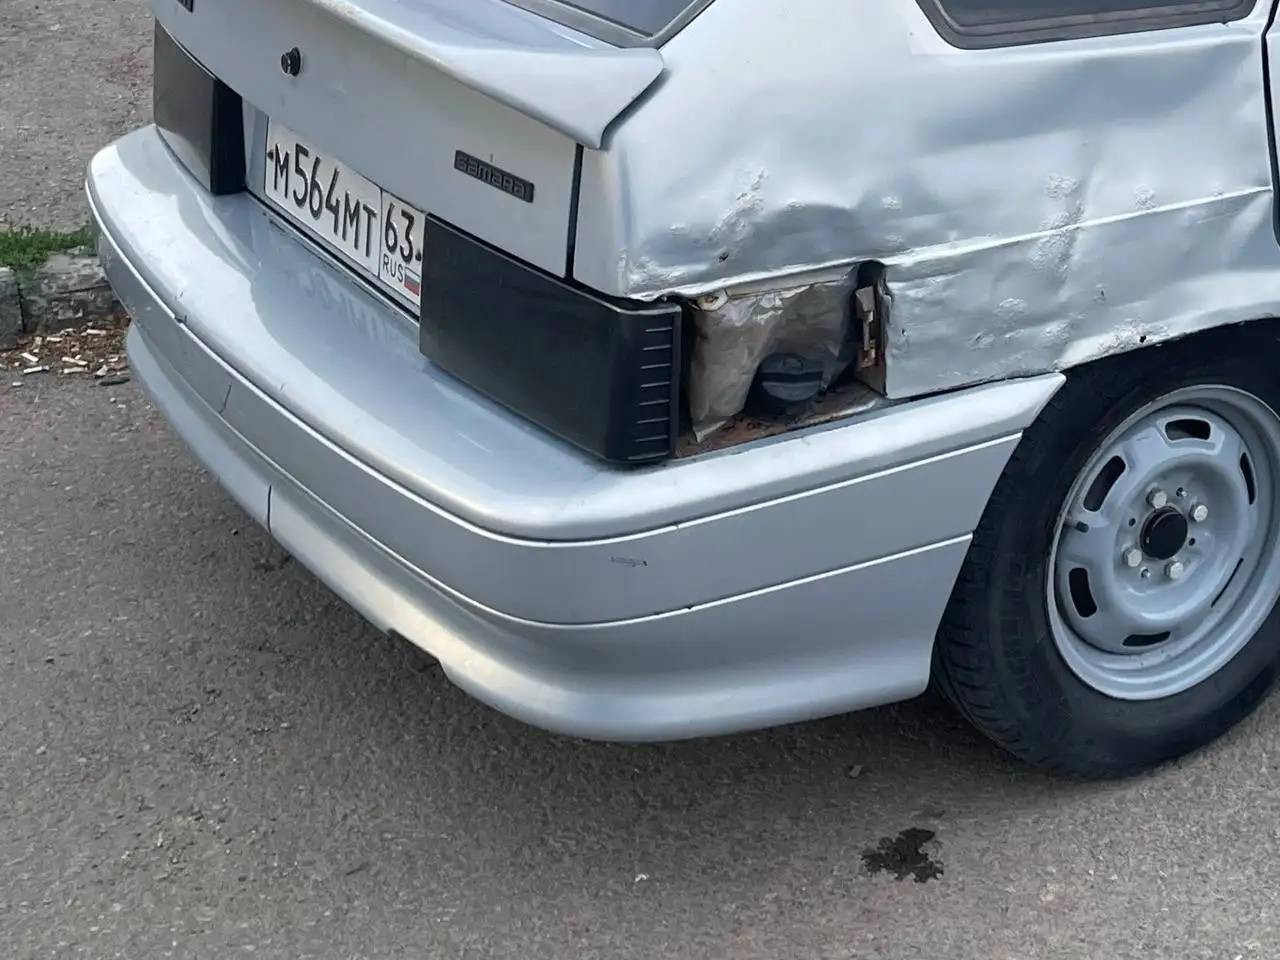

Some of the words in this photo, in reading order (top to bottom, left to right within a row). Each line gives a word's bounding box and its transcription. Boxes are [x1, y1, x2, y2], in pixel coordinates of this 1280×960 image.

[273, 142, 377, 258] М564МТ
[385, 201, 415, 264] 63
[382, 253, 404, 283] RUS
